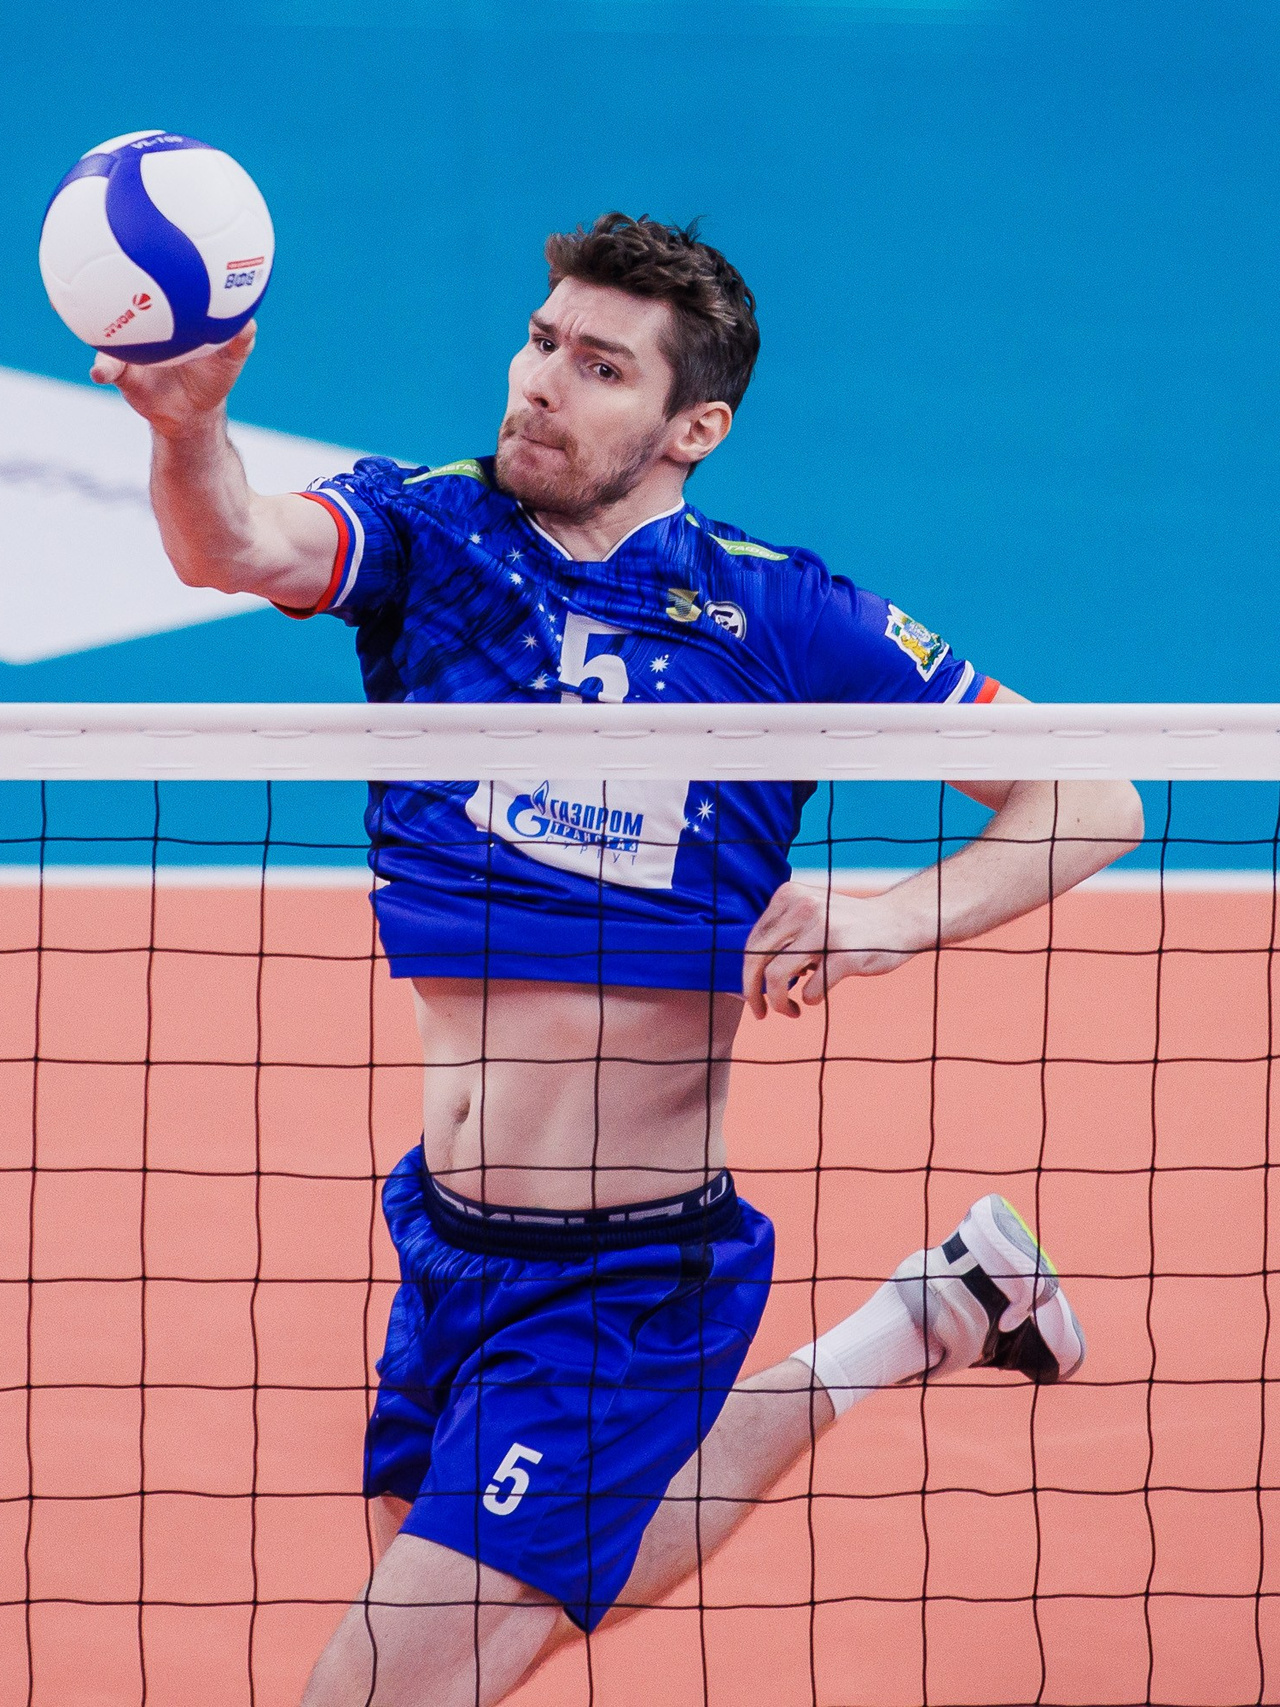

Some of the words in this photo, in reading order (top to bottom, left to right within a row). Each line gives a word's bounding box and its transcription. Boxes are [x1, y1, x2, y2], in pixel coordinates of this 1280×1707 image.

[558, 611, 632, 703] 5
[550, 799, 644, 837] ГАЗПРОМ
[482, 1442, 542, 1515] 5
